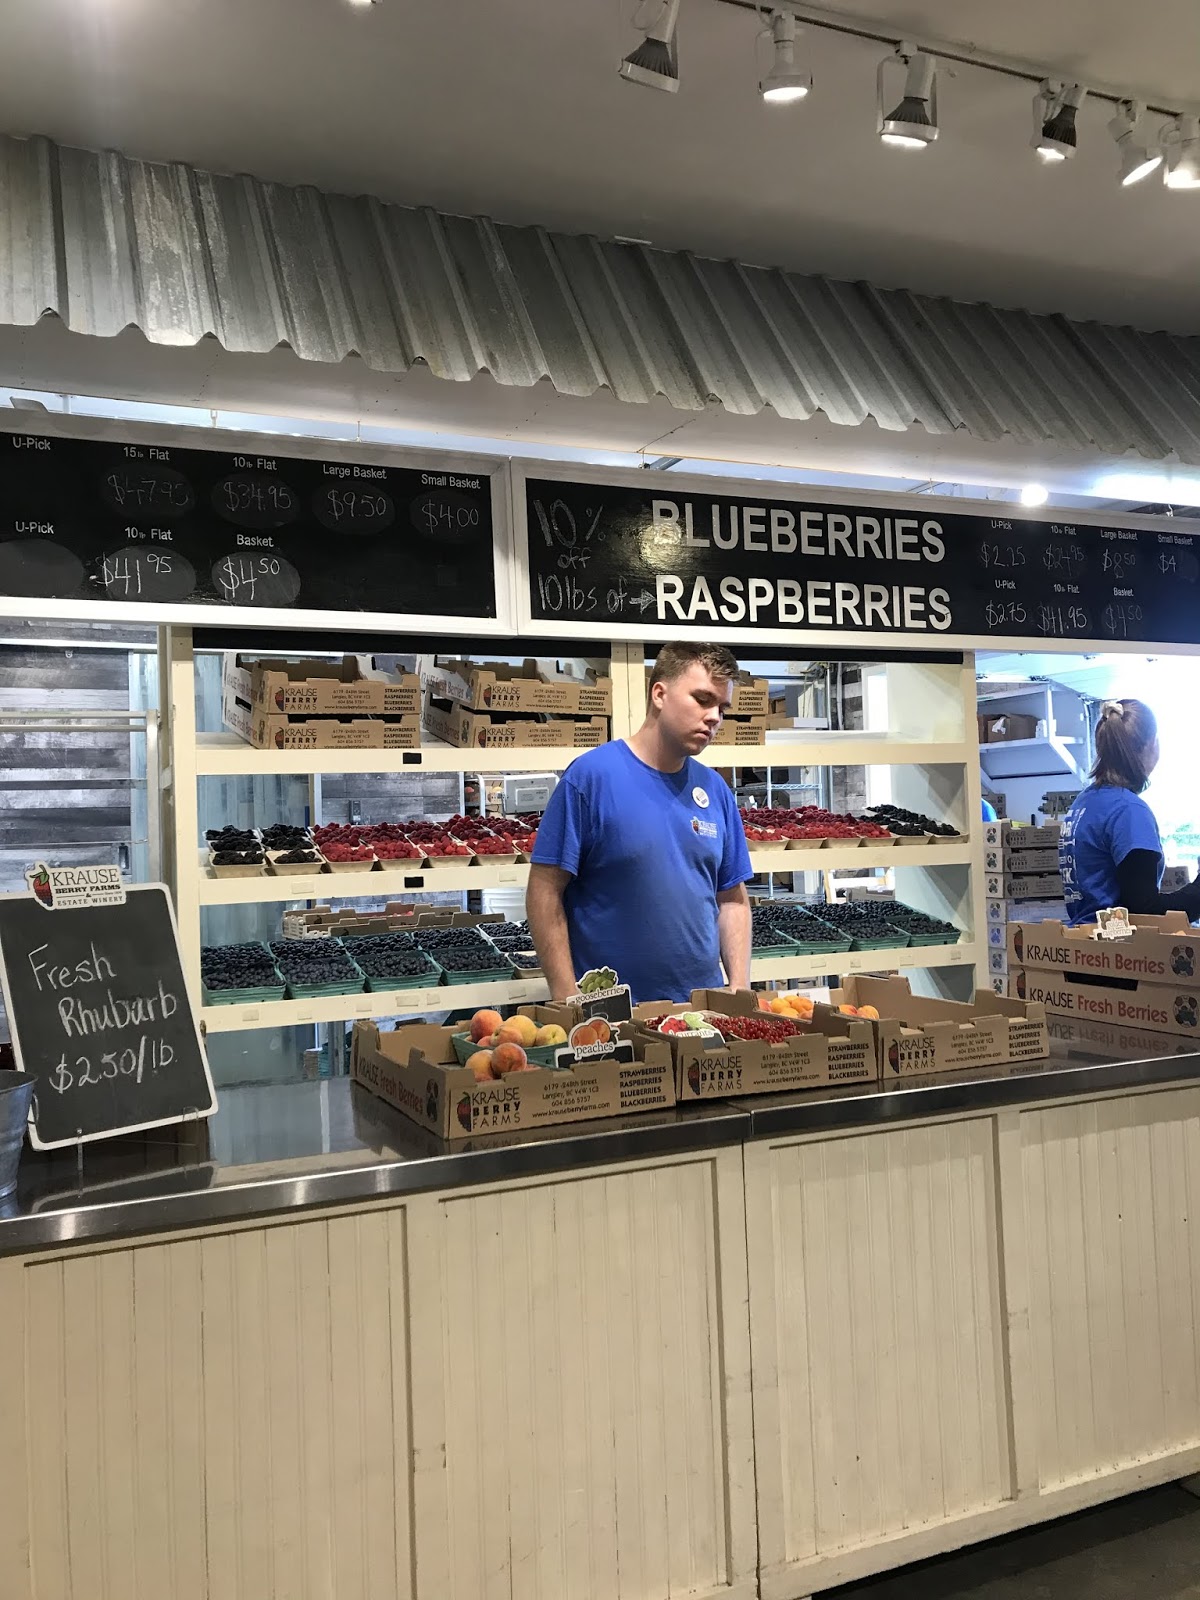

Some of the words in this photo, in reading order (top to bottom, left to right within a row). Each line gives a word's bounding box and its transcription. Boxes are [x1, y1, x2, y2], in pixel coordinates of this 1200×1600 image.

[12, 437, 51, 450] U-Pick
[149, 449, 170, 461] Flat
[257, 458, 277, 470] Flat
[323, 464, 350, 479] Large
[353, 466, 387, 480] Basket
[421, 473, 447, 487] Small
[449, 476, 481, 490] Basket
[327, 489, 387, 521] $9.50
[15, 521, 54, 534] U-Pick
[652, 500, 945, 562] BLUEBERRIES
[991, 519, 1012, 531] U-Pick
[1064, 526, 1076, 536] Flat
[151, 528, 173, 541] Flat
[1100, 530, 1117, 540] Large
[1117, 531, 1138, 541] Basket
[1157, 534, 1173, 544] Small
[1174, 536, 1194, 546] Basket
[236, 534, 274, 548] Basket
[557, 546, 592, 569] off
[1158, 552, 1176, 574] $4
[995, 579, 1016, 590] U-Pick
[1067, 584, 1080, 595] Flat
[1113, 587, 1134, 597] Basket
[656, 574, 952, 630] RASPBERRIES
[284, 688, 317, 697] KRAUSE
[492, 686, 521, 694] KRAUSE
[285, 703, 317, 711] FARMS
[284, 728, 317, 737] KRAUSE
[486, 727, 516, 736] KRAUSE
[51, 868, 120, 887] KRAUSE
[55, 886, 87, 894] BERRY
[90, 884, 121, 892] FARMS
[57, 898, 88, 907] ESTATE
[92, 896, 123, 904] WINERY
[1027, 945, 1071, 964] KRAUSE
[1074, 951, 1110, 968] Fresh
[1115, 954, 1165, 974] Berries
[28, 941, 117, 992] Fresh
[575, 986, 624, 1005] gooseberries
[58, 980, 177, 1037] Rhubarb
[1029, 988, 1074, 1009] KRAUSE
[1077, 994, 1113, 1015] Fresh
[1118, 1002, 1168, 1024] Berries
[1008, 1022, 1044, 1032] STRAWBERRIES
[1008, 1031, 1041, 1040] RASPBERRIES
[576, 1040, 614, 1058] peaches
[828, 1043, 869, 1053] STRAWBERRIES
[900, 1037, 935, 1051] KRAUSE
[1009, 1039, 1040, 1049] BLUEBERRIES
[828, 1052, 865, 1062] RASPBERRIES
[900, 1049, 936, 1060] BERRY
[1009, 1047, 1044, 1057] BLACKBERRIES
[700, 1056, 742, 1070] KRAUSE
[828, 1061, 865, 1071] BLUEBERRIES
[900, 1060, 936, 1071] FARMS
[619, 1066, 667, 1078] STRAWBERRIES
[701, 1069, 742, 1081] BERRY
[828, 1070, 869, 1080] BLACKBERRIES
[359, 1055, 379, 1086] KRAUSE
[399, 1081, 423, 1115] Berries
[620, 1077, 662, 1088] RASPBERRIES
[701, 1081, 742, 1093] FARMS
[472, 1087, 520, 1104] KRAUSE
[620, 1086, 661, 1098] BLUEBERRIES
[620, 1095, 667, 1108] BLACKBERRIES
[473, 1101, 521, 1116] BERRY
[473, 1112, 521, 1129] FARMS
